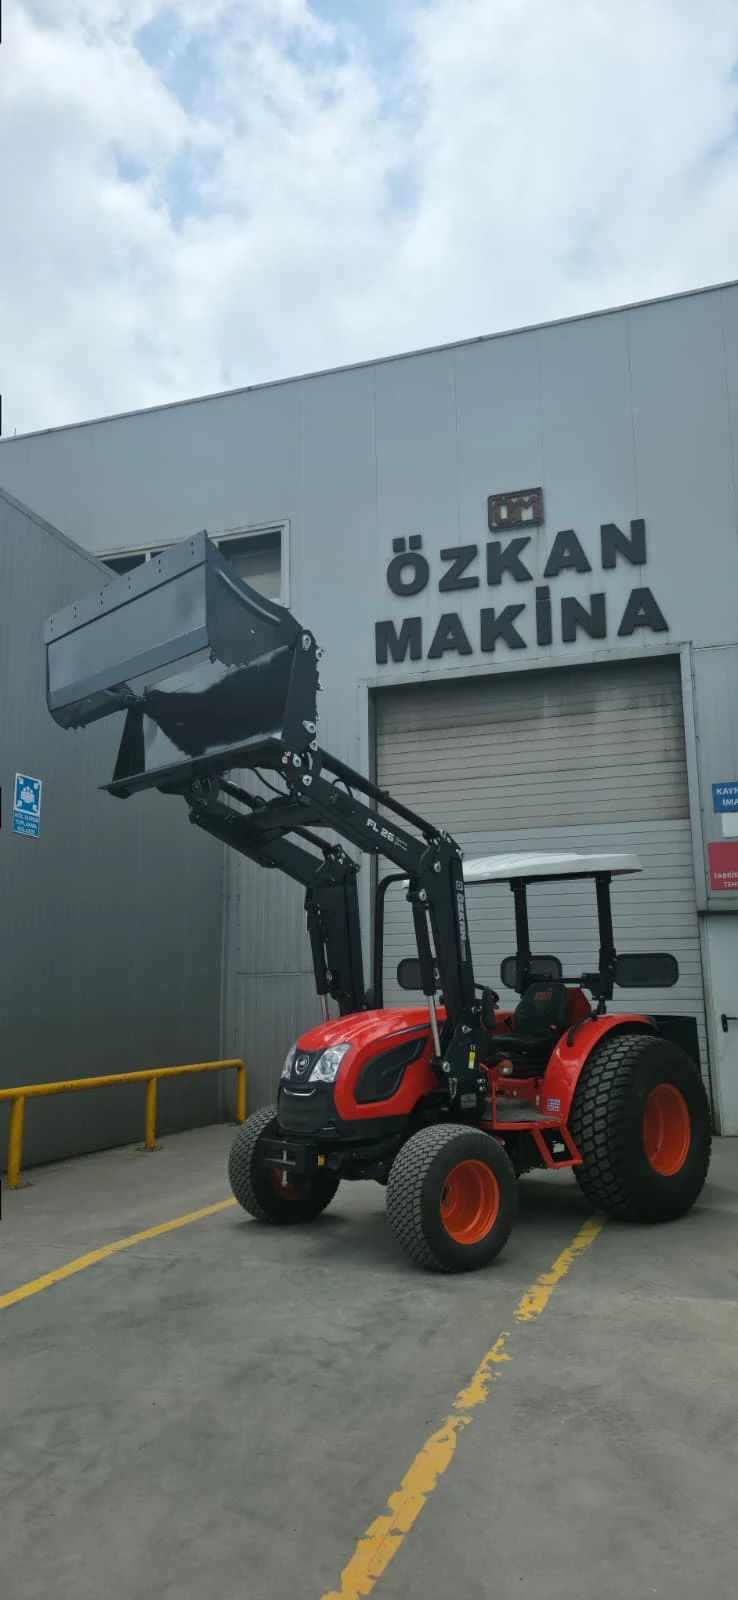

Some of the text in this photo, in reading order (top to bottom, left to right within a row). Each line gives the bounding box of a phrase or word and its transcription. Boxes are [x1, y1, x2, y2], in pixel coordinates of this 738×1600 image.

[386, 518, 647, 597] ÖZKAN
[375, 585, 669, 664] MAKİNA
[366, 818, 395, 842] FL 26
